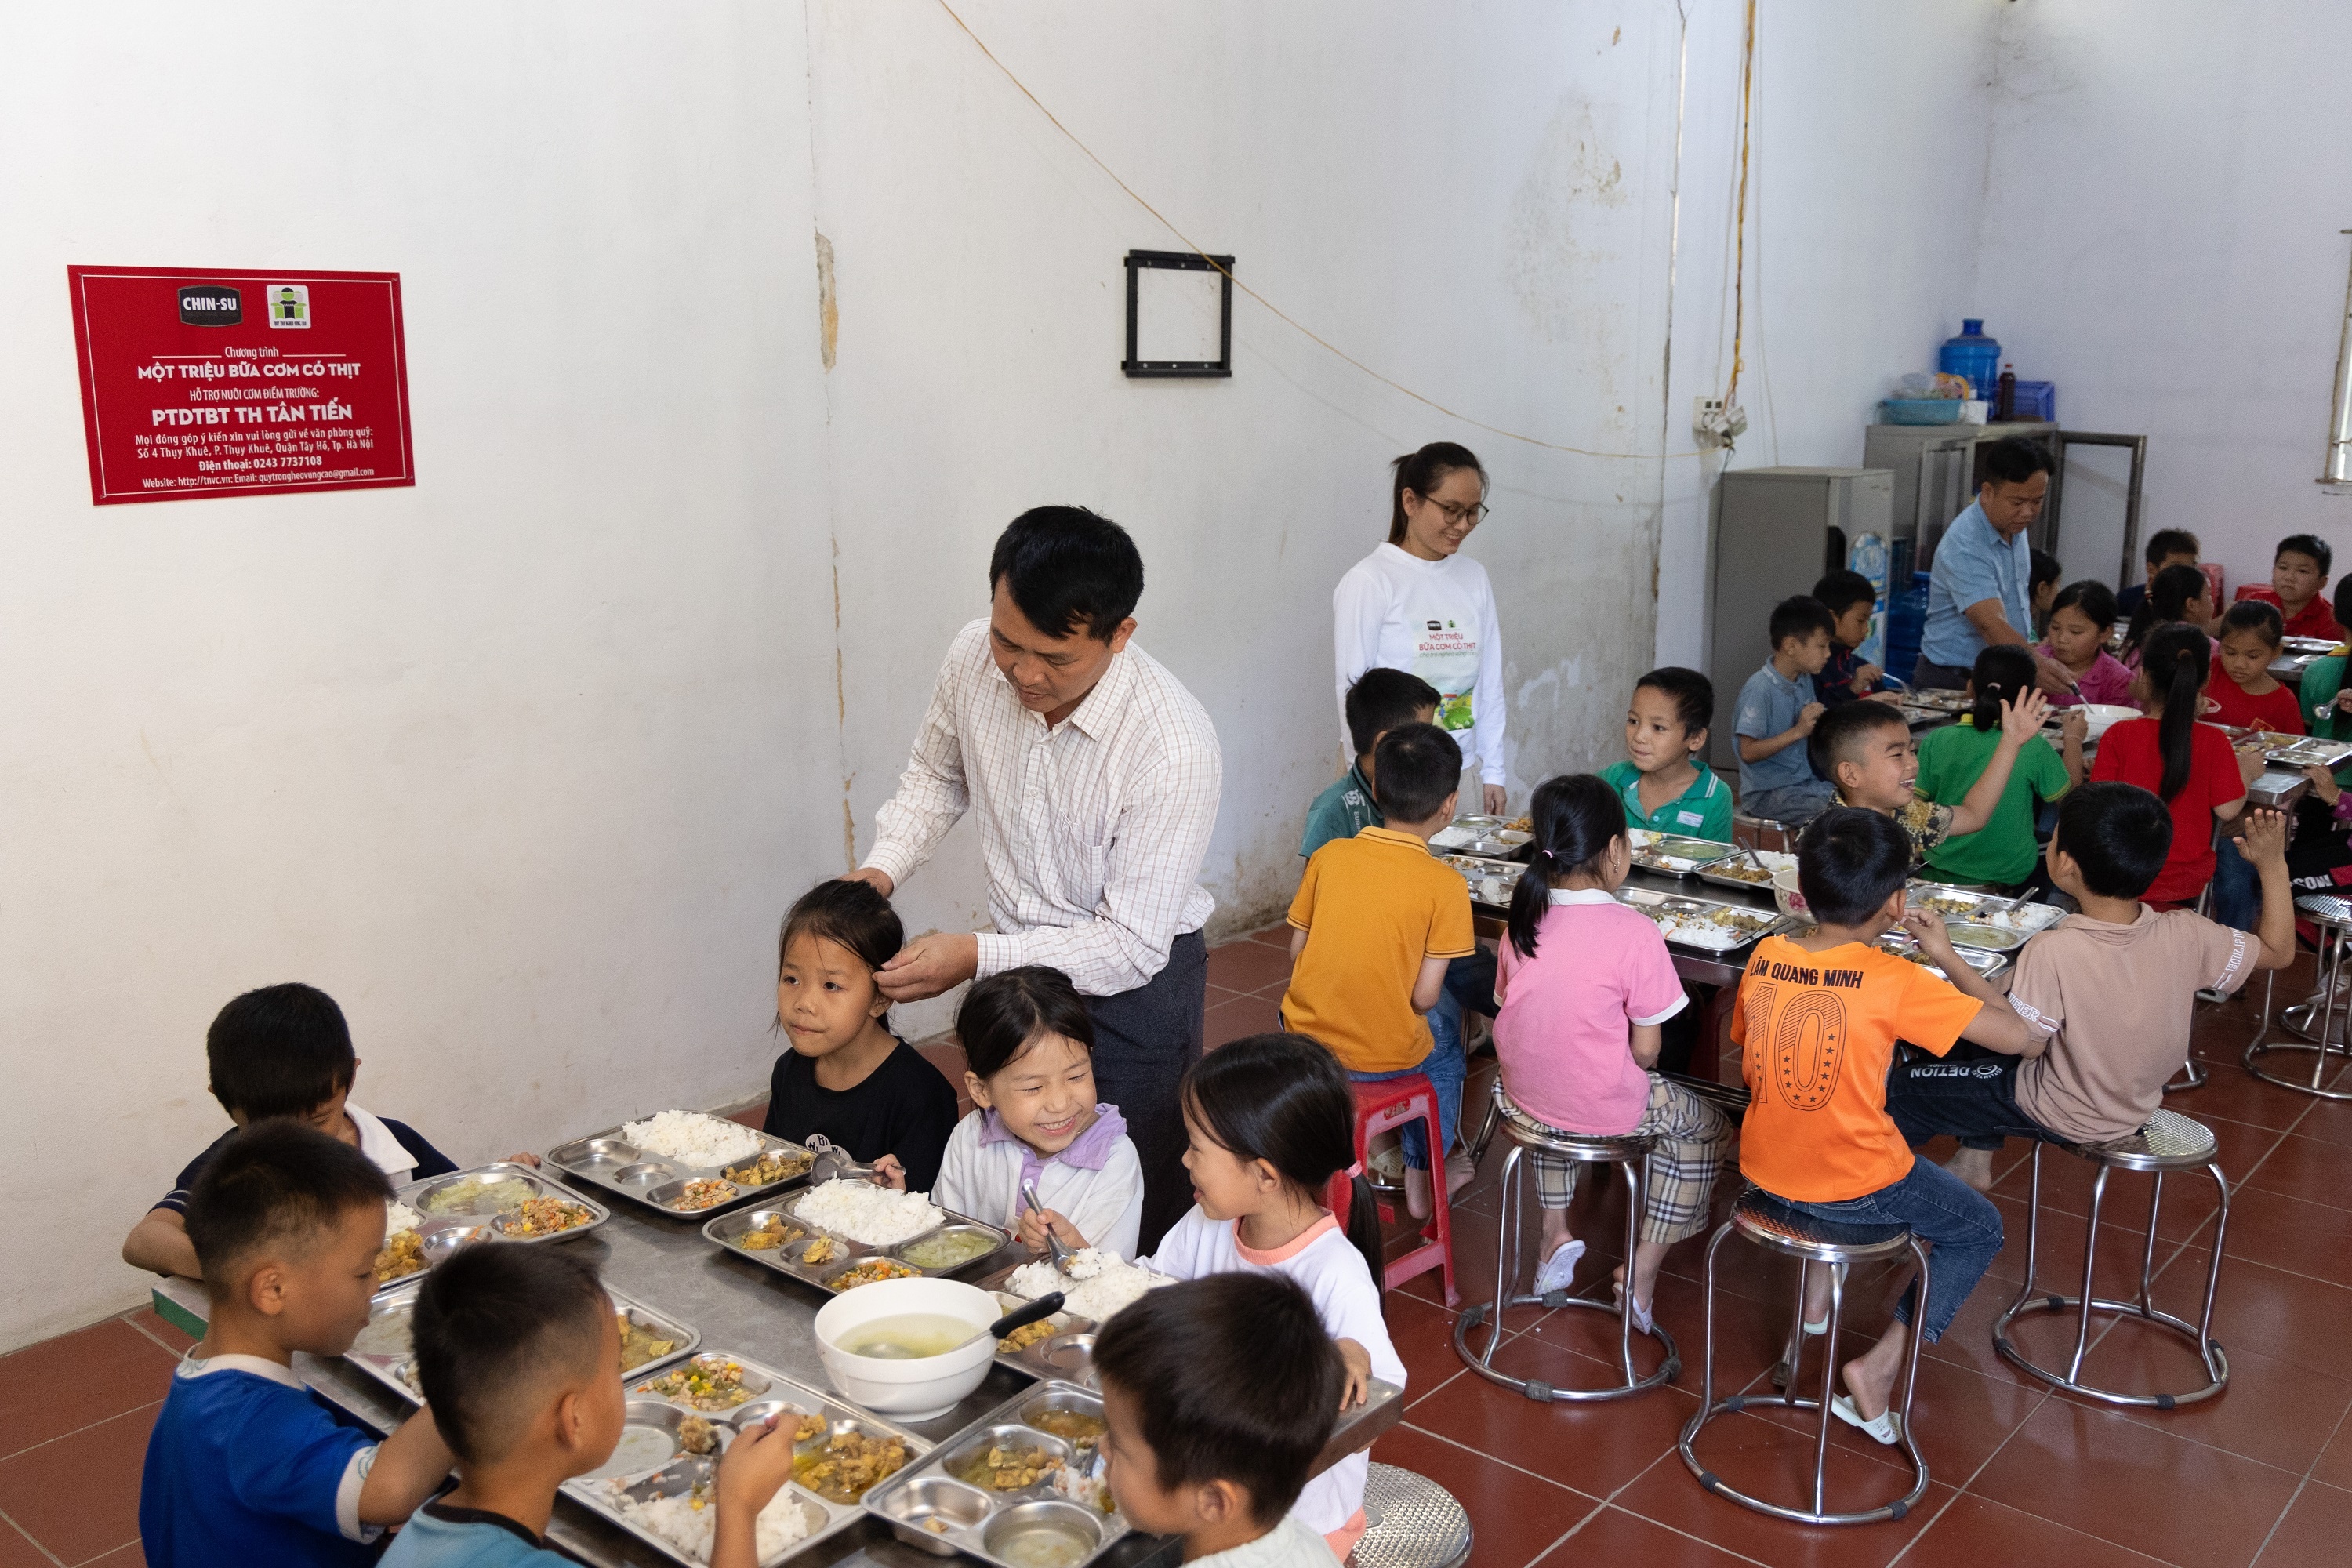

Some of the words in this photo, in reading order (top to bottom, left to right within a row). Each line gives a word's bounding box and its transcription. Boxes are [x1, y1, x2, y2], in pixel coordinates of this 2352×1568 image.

[183, 297, 237, 311] CHIN-SU
[224, 347, 257, 360] Chương
[259, 346, 279, 358] trình
[138, 361, 175, 383] MỘT
[178, 361, 225, 382] TRIỆU
[228, 361, 261, 377] BỮA
[263, 363, 299, 376] CƠM
[302, 360, 325, 376] CÓ
[328, 363, 361, 379] THỊT
[190, 387, 202, 401] HỖ
[203, 389, 220, 403] TRỢ
[221, 387, 241, 401] NUÔI
[244, 388, 262, 400] CƠM
[263, 386, 283, 399] ĐIỂM
[284, 386, 320, 398] TRƯỜNG:
[152, 407, 230, 426] PTDTBT
[234, 407, 263, 423] TH
[266, 401, 305, 423] TÂN
[309, 397, 352, 421] TIẾN
[136, 434, 153, 447] Mọi
[156, 434, 179, 445] đóng
[181, 433, 198, 445] góp
[201, 433, 206, 445] ý
[209, 431, 227, 442] kiến
[230, 431, 243, 441] xin
[246, 430, 259, 441] vui
[262, 430, 281, 441] lòng
[283, 429, 296, 441] gửi
[311, 428, 325, 438] văn
[328, 427, 353, 439] phòng
[355, 426, 373, 438] quỹ:
[137, 447, 149, 459] Số
[152, 448, 158, 457] 4
[160, 447, 183, 459] Thụy
[185, 446, 212, 457] Khuê,
[214, 445, 222, 455] P.
[223, 445, 245, 456] Thụy
[248, 444, 274, 454] Khuê,
[275, 443, 297, 455] Quận
[299, 441, 314, 453] Tây
[332, 440, 344, 452] Tp.
[347, 440, 358, 449] Hà
[360, 439, 373, 450] Nội
[198, 461, 221, 474] Điện
[223, 459, 252, 471] thoại:
[253, 457, 278, 468] 0243
[281, 456, 322, 467] 7737108
[143, 478, 176, 488] Website:
[235, 473, 258, 483] Email:
[259, 467, 374, 484] quytrongheovungcao@gmail.com
[1750, 956, 1770, 977] LÂM
[1771, 963, 1819, 985] QUANG
[1823, 970, 1864, 989] MINH
[1744, 982, 1846, 1111] 10
[1911, 1066, 1970, 1078] DETION
